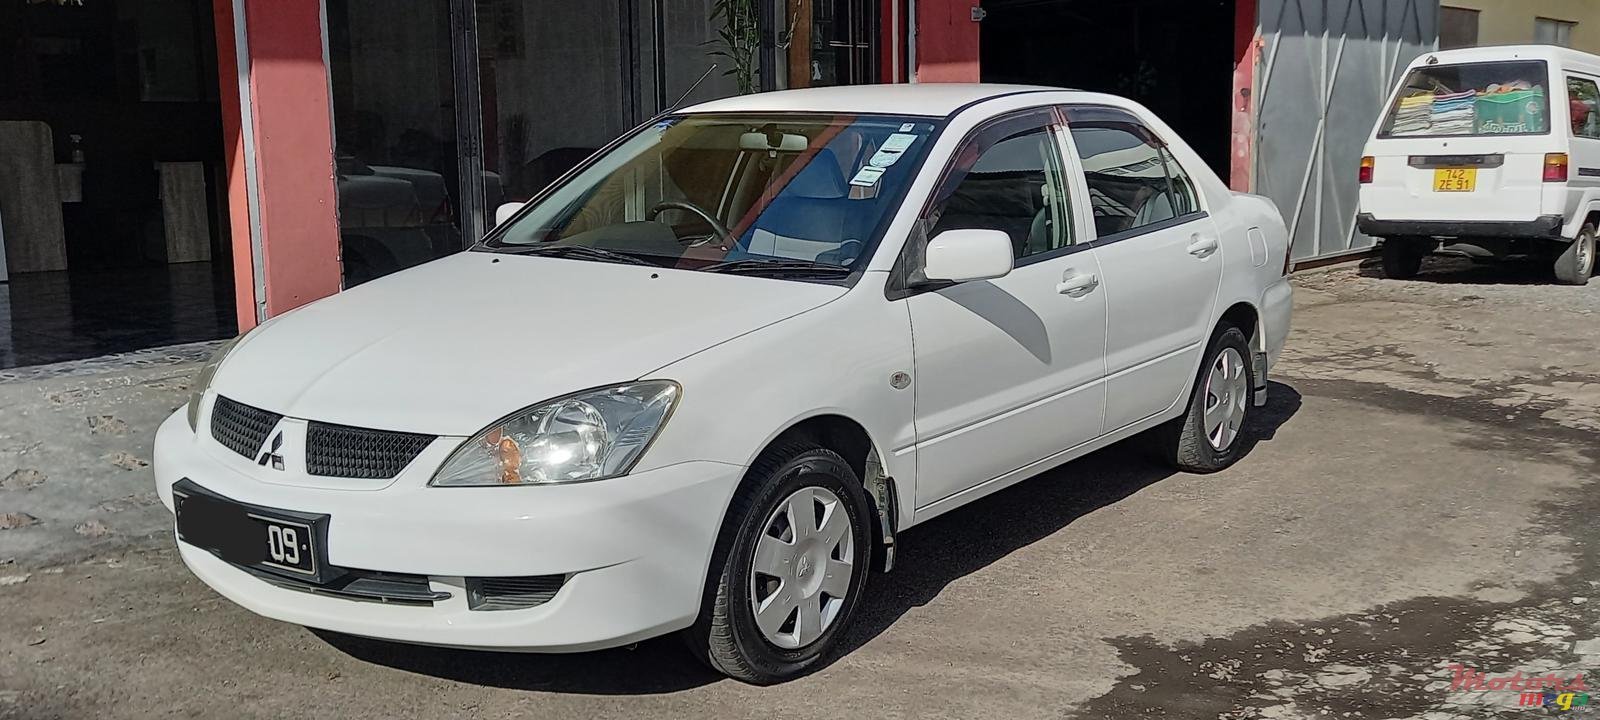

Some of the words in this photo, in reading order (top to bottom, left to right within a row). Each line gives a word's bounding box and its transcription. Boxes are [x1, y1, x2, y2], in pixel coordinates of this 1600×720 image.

[1446, 169, 1465, 179] 742
[1439, 179, 1453, 190] ZE
[1456, 179, 1469, 189] 91
[268, 524, 300, 564] 09
